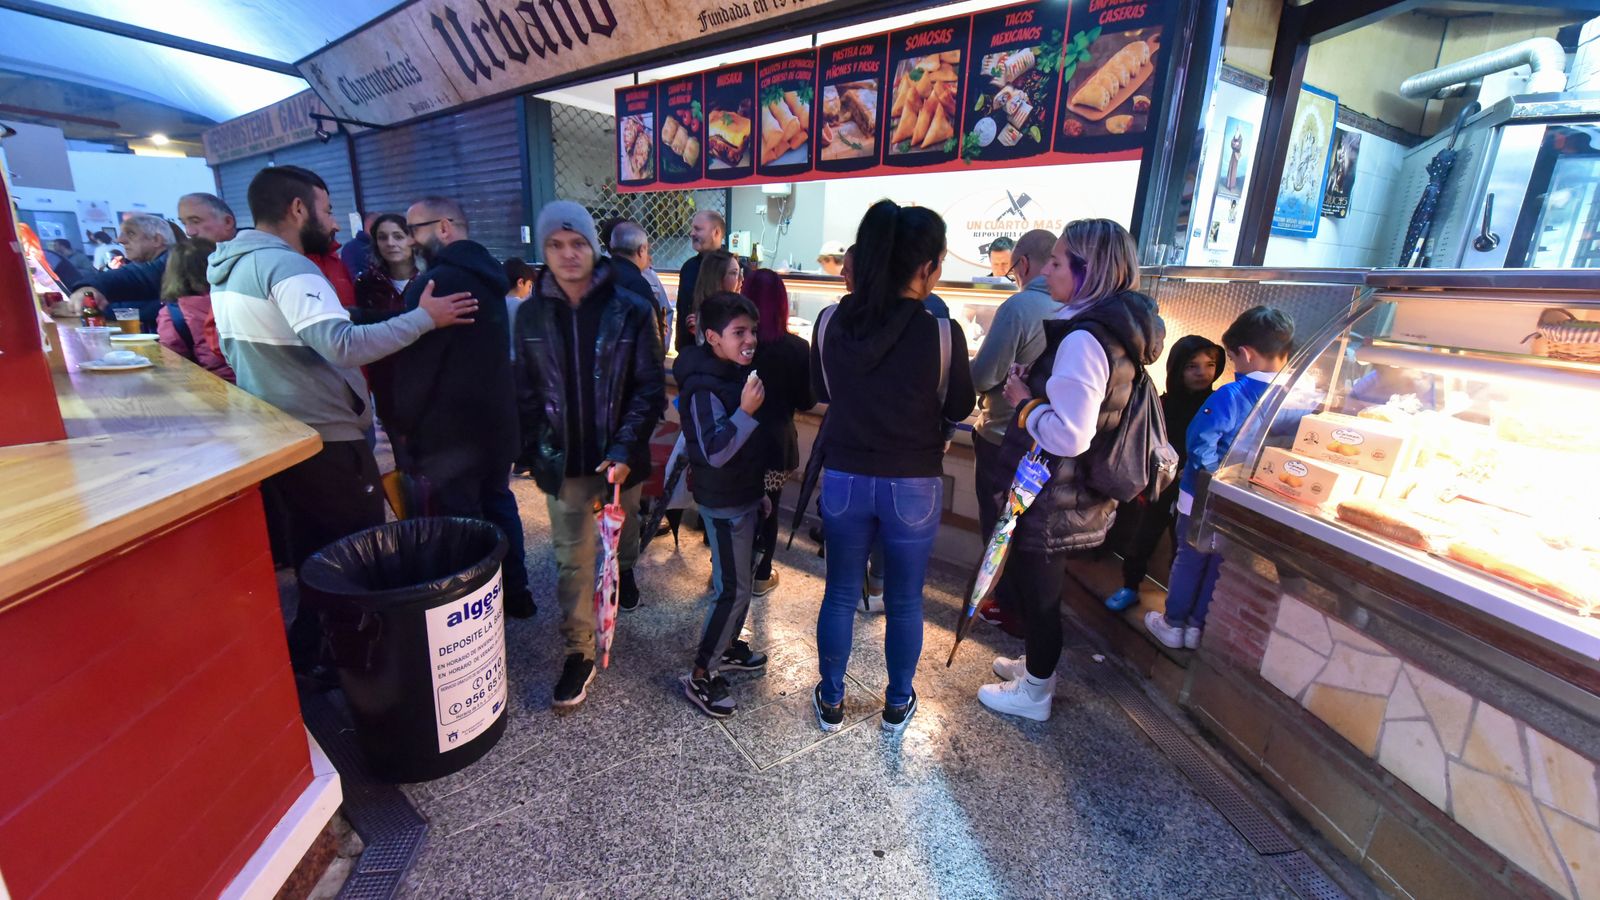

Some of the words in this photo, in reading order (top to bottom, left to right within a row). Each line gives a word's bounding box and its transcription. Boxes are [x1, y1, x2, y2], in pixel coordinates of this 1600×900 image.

[698, 3, 750, 32] Fundada
[1005, 9, 1035, 27] TACOS
[1099, 3, 1148, 24] CASERAS
[430, 0, 617, 85] Urbano
[905, 28, 954, 51] SOMOSAS
[990, 27, 1042, 47] MEXICANOS
[832, 46, 859, 62] PASTELA
[860, 44, 874, 56] CON
[825, 62, 851, 80] PIÑONES
[853, 63, 858, 73] Y
[857, 61, 880, 73] PASAS
[967, 221, 982, 230] UN
[985, 220, 1029, 230] CUARTO
[1033, 220, 1062, 230] MAS
[439, 628, 483, 657] DEPOSITE
[484, 621, 493, 633] LA
[447, 653, 470, 668] HORARIO
[470, 648, 477, 656] DE
[448, 661, 472, 675] HORARIO
[485, 657, 502, 680] 010
[465, 688, 485, 707] 956
[487, 677, 497, 692] 65
